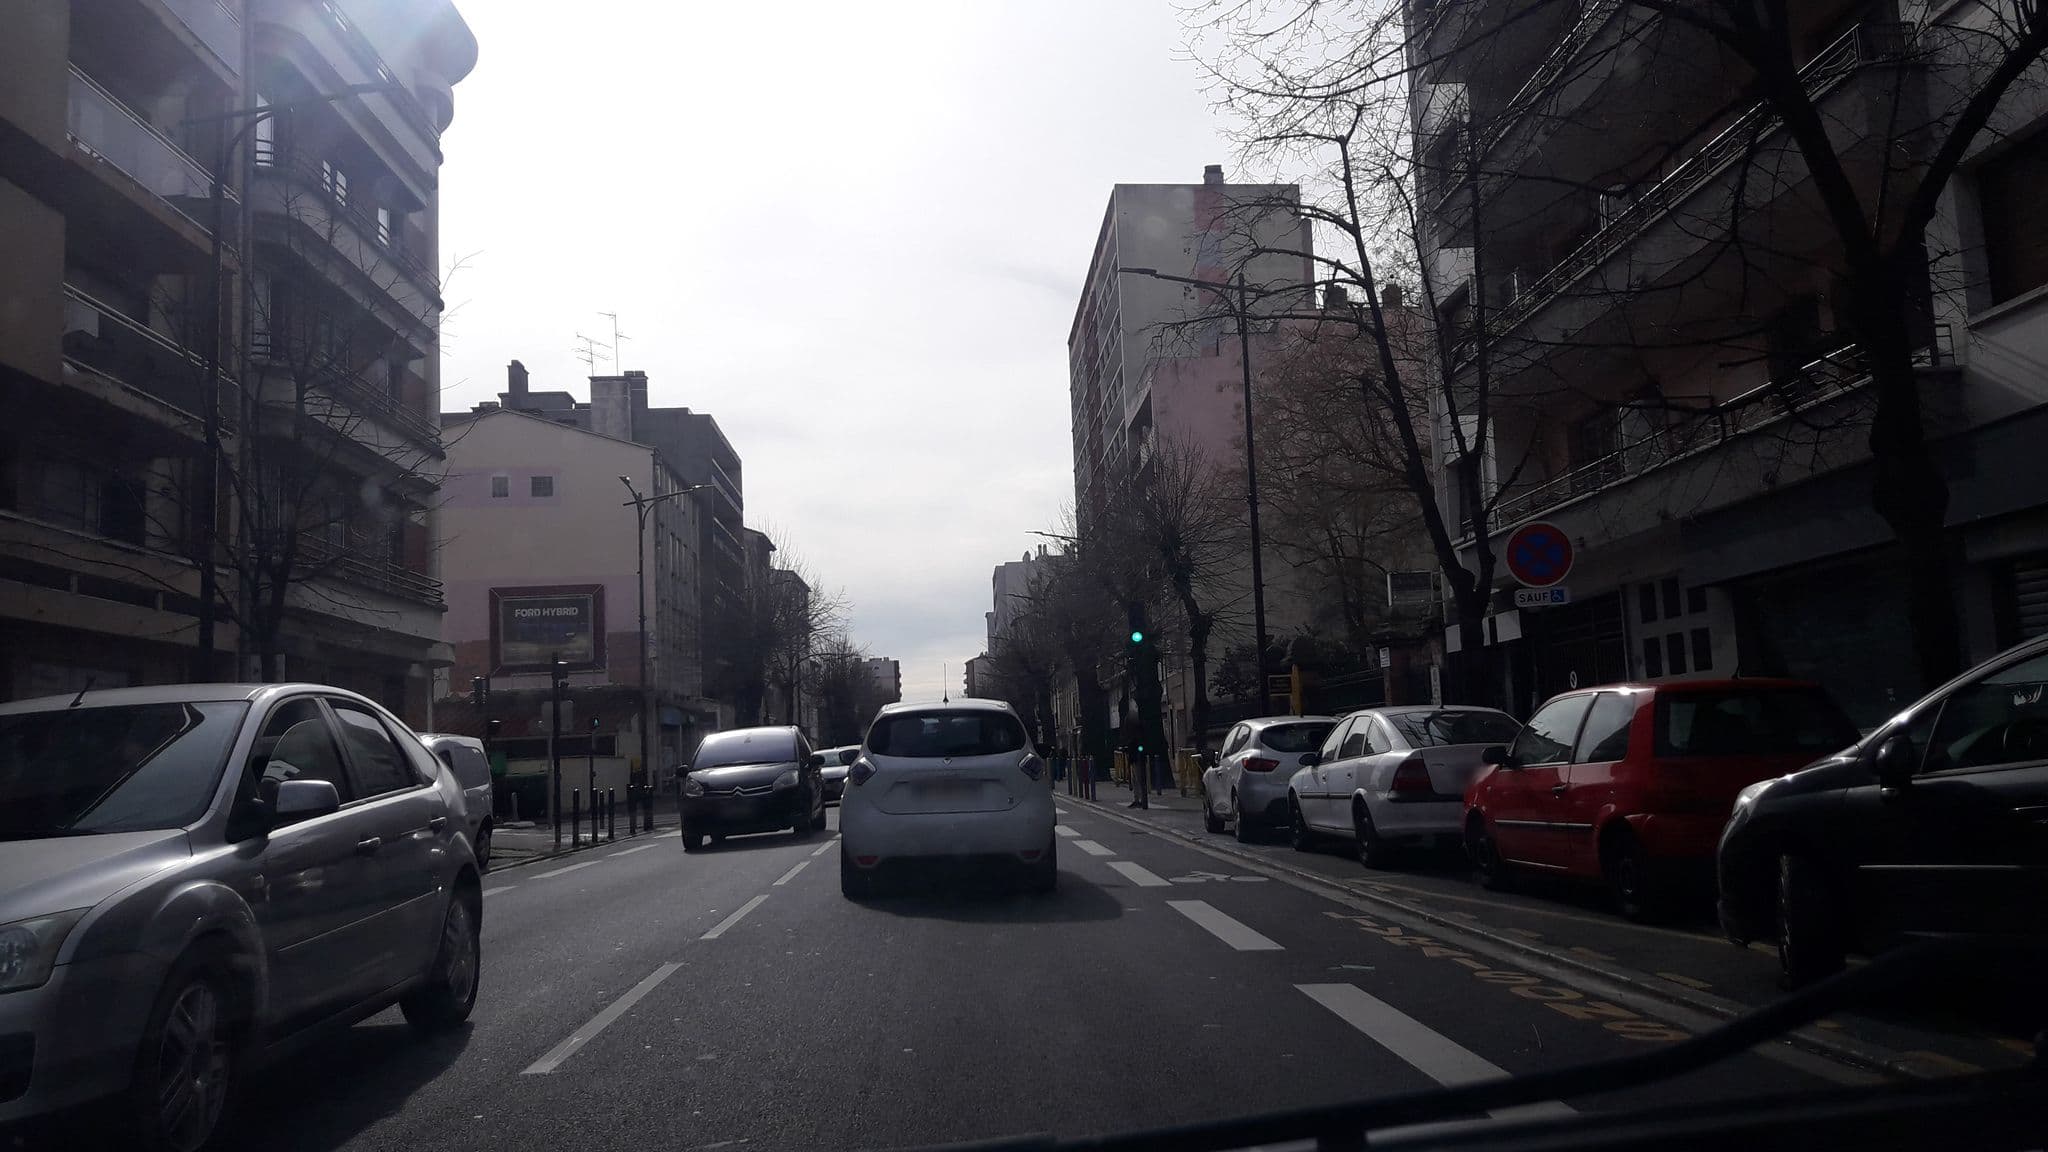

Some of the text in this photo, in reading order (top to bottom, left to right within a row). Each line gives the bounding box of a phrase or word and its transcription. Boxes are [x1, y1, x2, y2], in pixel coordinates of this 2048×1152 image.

[1518, 592, 1550, 603] SAUF
[514, 607, 578, 617] FORD HYBRID
